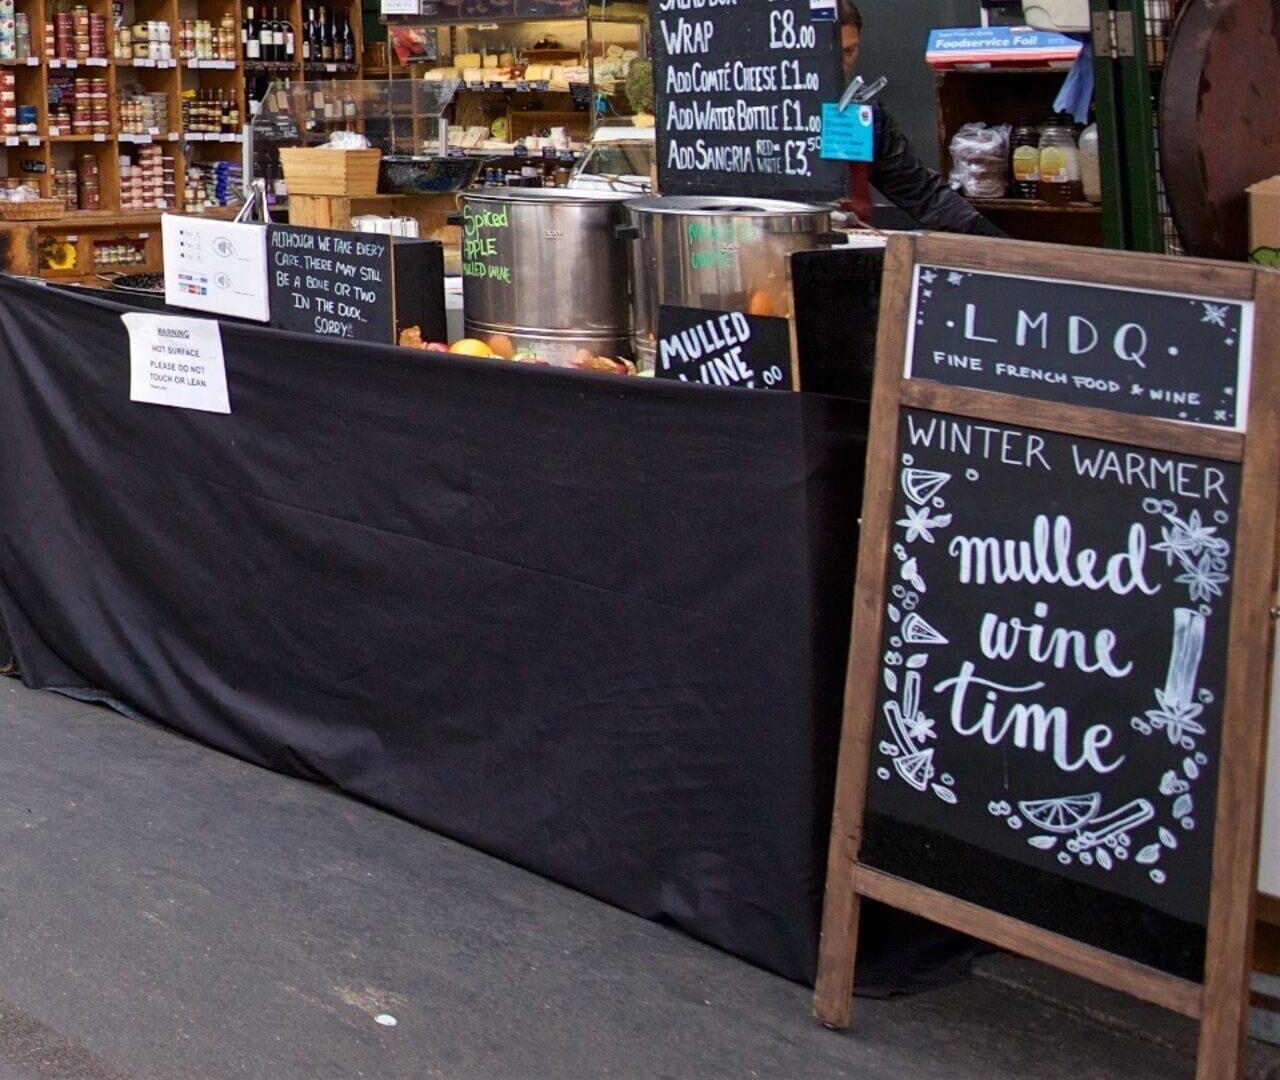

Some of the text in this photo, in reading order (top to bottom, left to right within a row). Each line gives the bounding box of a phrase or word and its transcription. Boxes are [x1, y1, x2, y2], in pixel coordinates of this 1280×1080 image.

[936, 36, 1010, 49] Foodservice
[1013, 36, 1038, 46] Foil
[463, 204, 509, 240] Spiced
[271, 231, 385, 258] ALTHOUGH WE TAKE EVERY
[463, 238, 498, 260] APPLE
[304, 255, 382, 282] THERE MAY STILL
[276, 271, 376, 303] BE A BONE OR TWO
[291, 292, 310, 309] IN
[315, 297, 334, 314] THE
[157, 327, 190, 339] WARNING
[659, 311, 752, 370] MULLED
[151, 344, 166, 353] HOT
[149, 372, 172, 382] TOUCH
[174, 375, 186, 384] OR
[150, 360, 205, 375] PLEASE DO NOT
[933, 351, 983, 371] FINE
[995, 362, 1068, 385] FRENCH
[1071, 374, 1121, 393] FOOD
[1149, 388, 1201, 406] WINE
[907, 415, 1230, 505] WINTER WARMER
[949, 514, 1162, 596] mulled
[980, 602, 1134, 678] wine
[933, 661, 1126, 774] time
